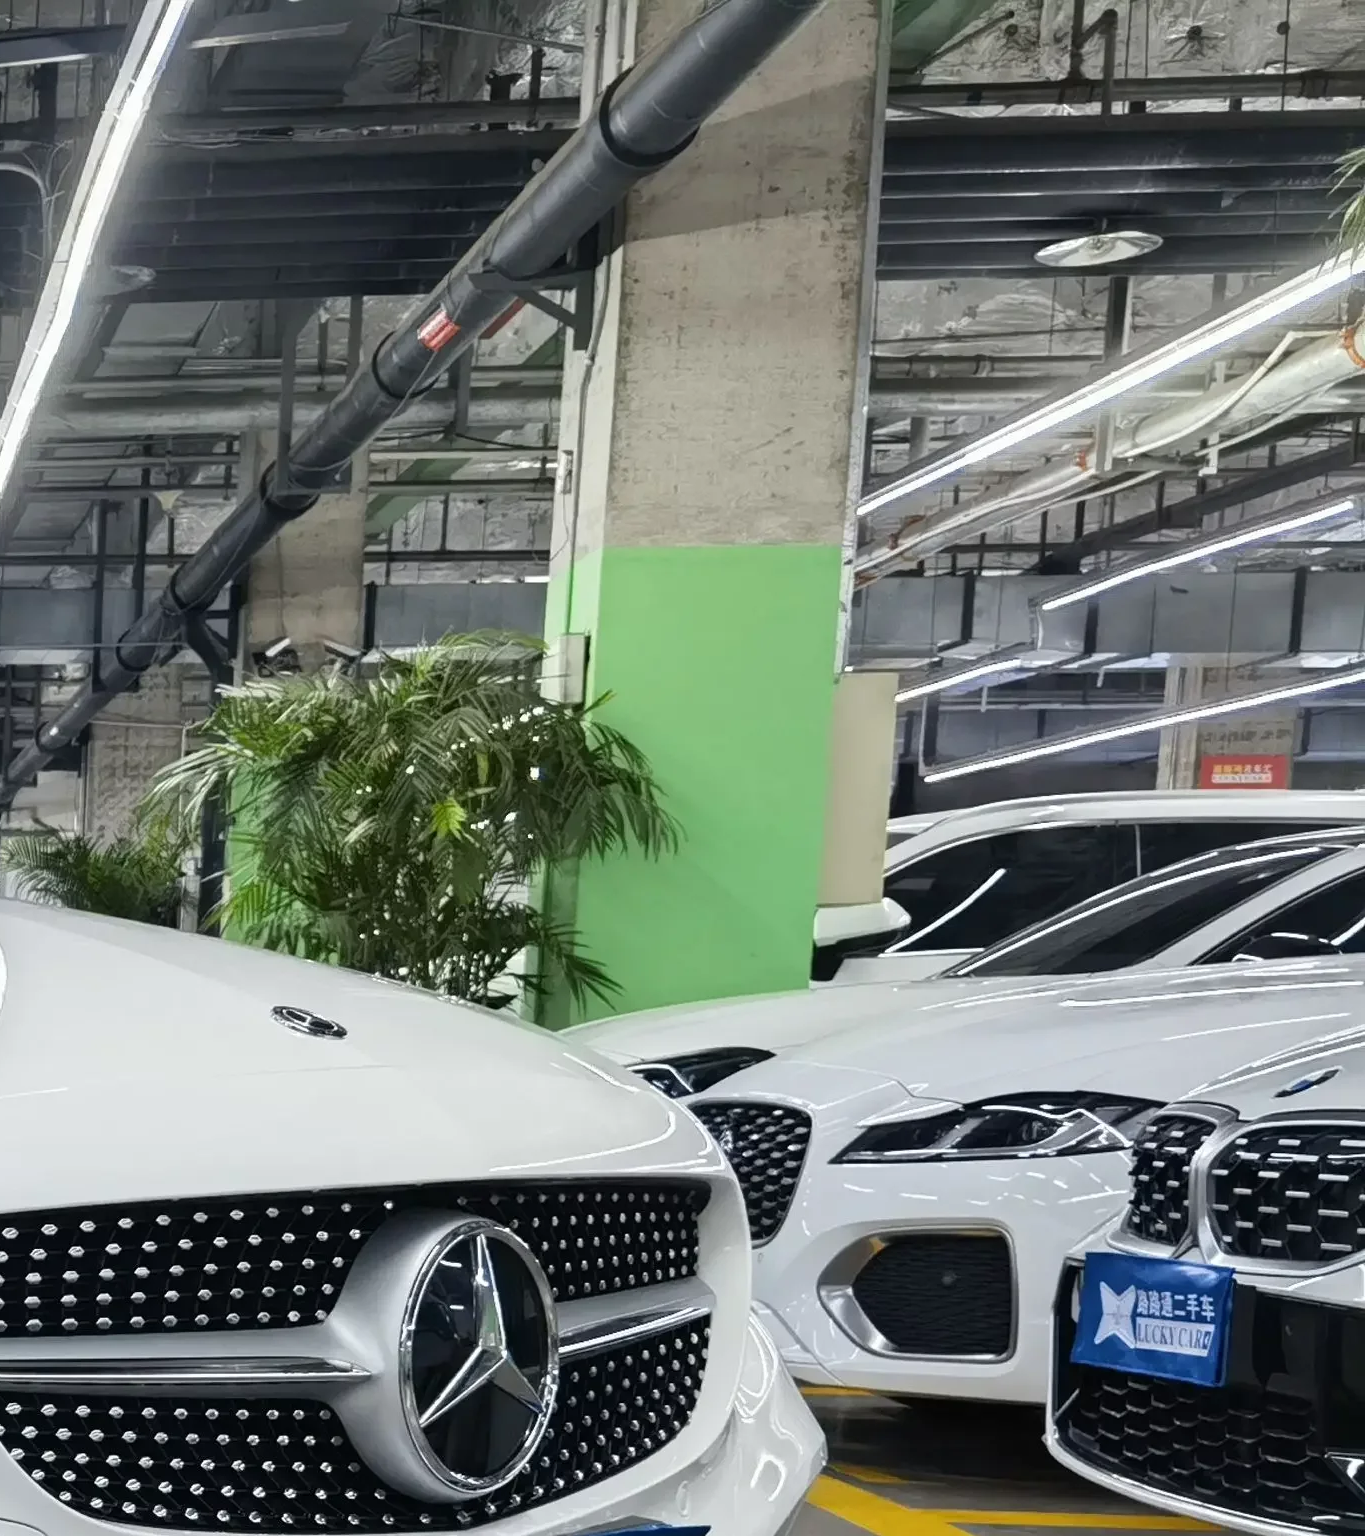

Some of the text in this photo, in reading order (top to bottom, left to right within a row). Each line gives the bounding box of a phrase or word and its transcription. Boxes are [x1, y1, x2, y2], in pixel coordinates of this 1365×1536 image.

[1136, 1289, 1215, 1322] 路路通二手车
[1137, 1321, 1204, 1350] LUCKY CAR
